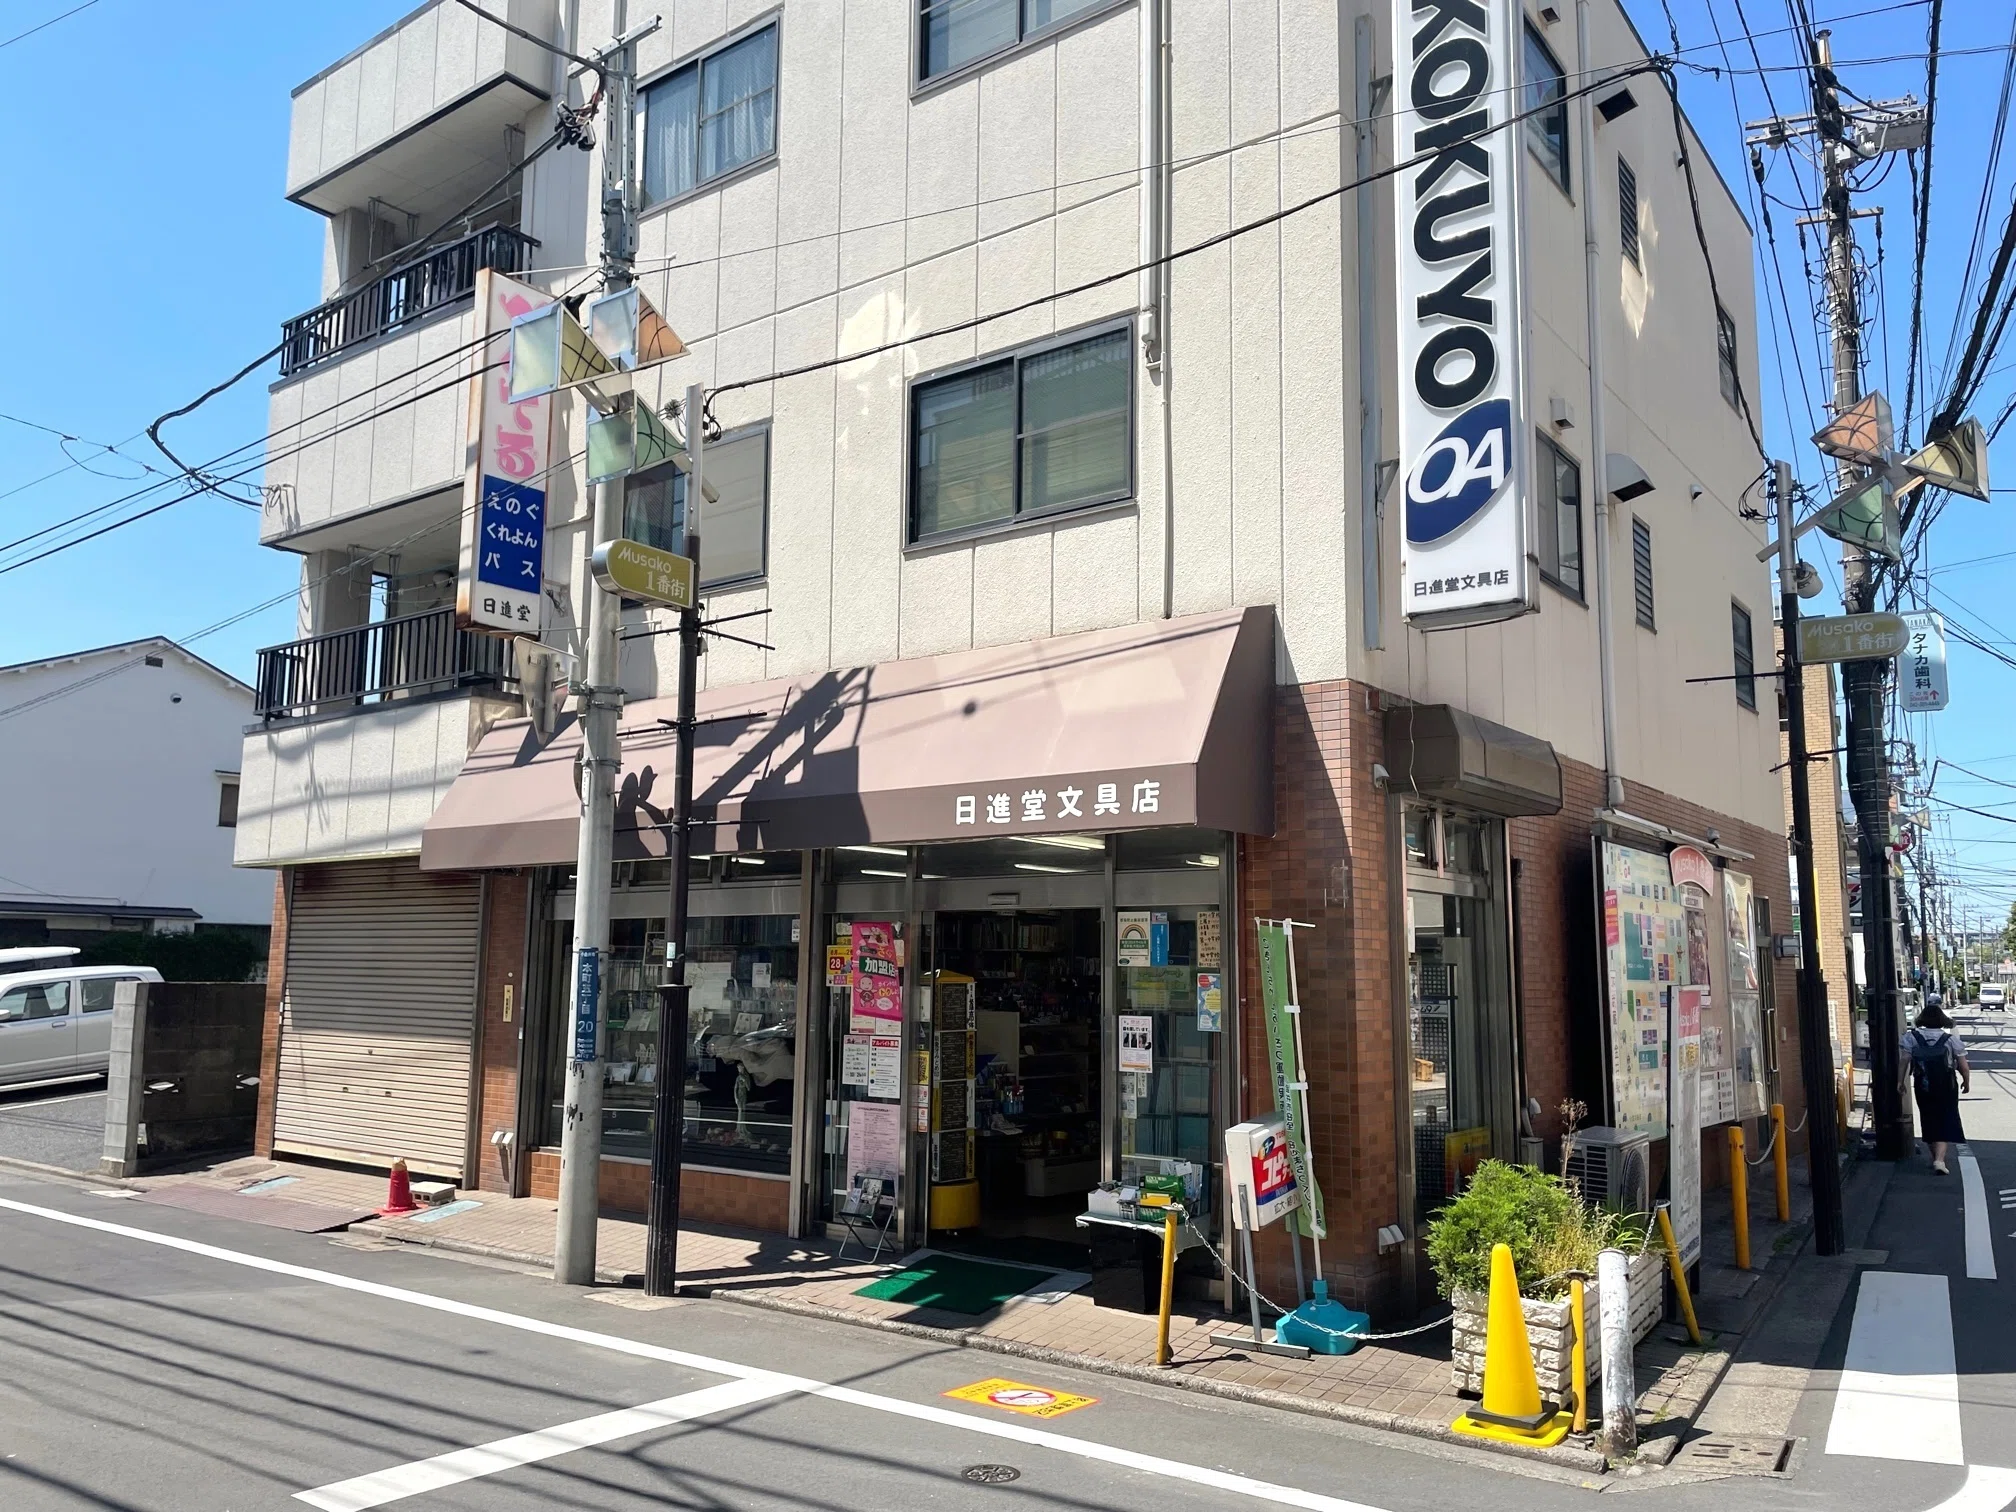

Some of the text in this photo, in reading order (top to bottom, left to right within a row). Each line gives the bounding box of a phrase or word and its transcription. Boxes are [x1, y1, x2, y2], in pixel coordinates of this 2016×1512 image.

[1410, 0, 1495, 407] KOKUYO
[1408, 428, 1504, 503] OA
[488, 492, 539, 520] えのぐ
[486, 522, 537, 548] くれよん
[618, 546, 672, 573] Musako
[645, 571, 686, 598] 1番街
[1414, 569, 1509, 597] 日進堂文具店
[483, 597, 531, 622] 日進堂
[1807, 619, 1874, 637] Musako
[1841, 632, 1894, 652] 1番街
[1912, 632, 1932, 689] タナカ歯科
[956, 779, 1160, 825] 日進堂文具店
[830, 958, 841, 969] 28
[864, 957, 896, 977] 加盟店
[577, 1020, 594, 1033] 20
